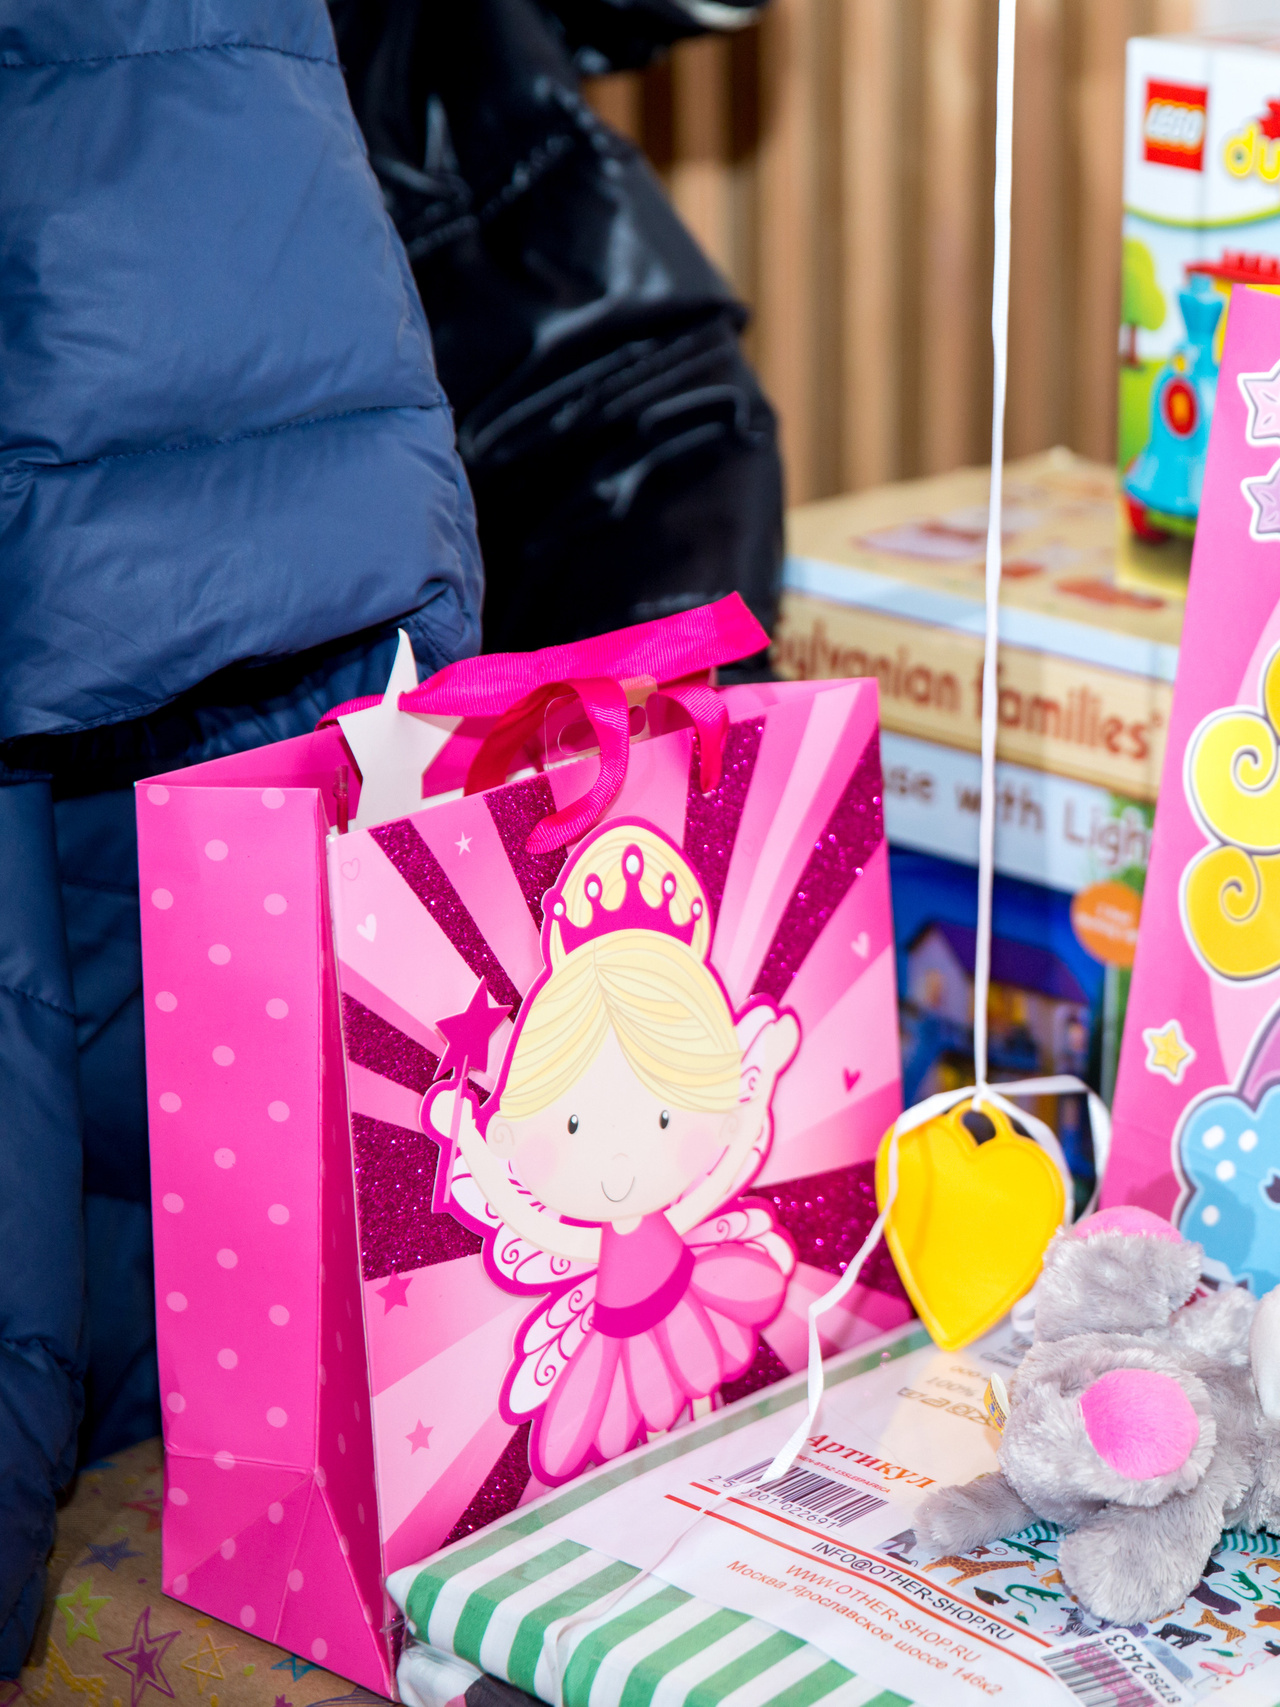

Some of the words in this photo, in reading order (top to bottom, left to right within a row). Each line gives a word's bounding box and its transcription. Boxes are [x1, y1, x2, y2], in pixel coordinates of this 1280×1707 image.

[1146, 103, 1203, 146] LEGO
[955, 778, 1046, 833] wth
[1063, 797, 1149, 868] Ligh
[708, 1475, 721, 1483] 2
[781, 1504, 836, 1529] 022691
[807, 1434, 938, 1489] Артикул
[727, 1560, 787, 1590] Москва
[787, 1583, 894, 1642] Ярославское
[894, 1640, 949, 1671] шоссе
[786, 1564, 981, 1663] WWW.OTHER-SHOP.RU
[812, 1541, 1014, 1640] INFO@OTHER-SHOP.RU
